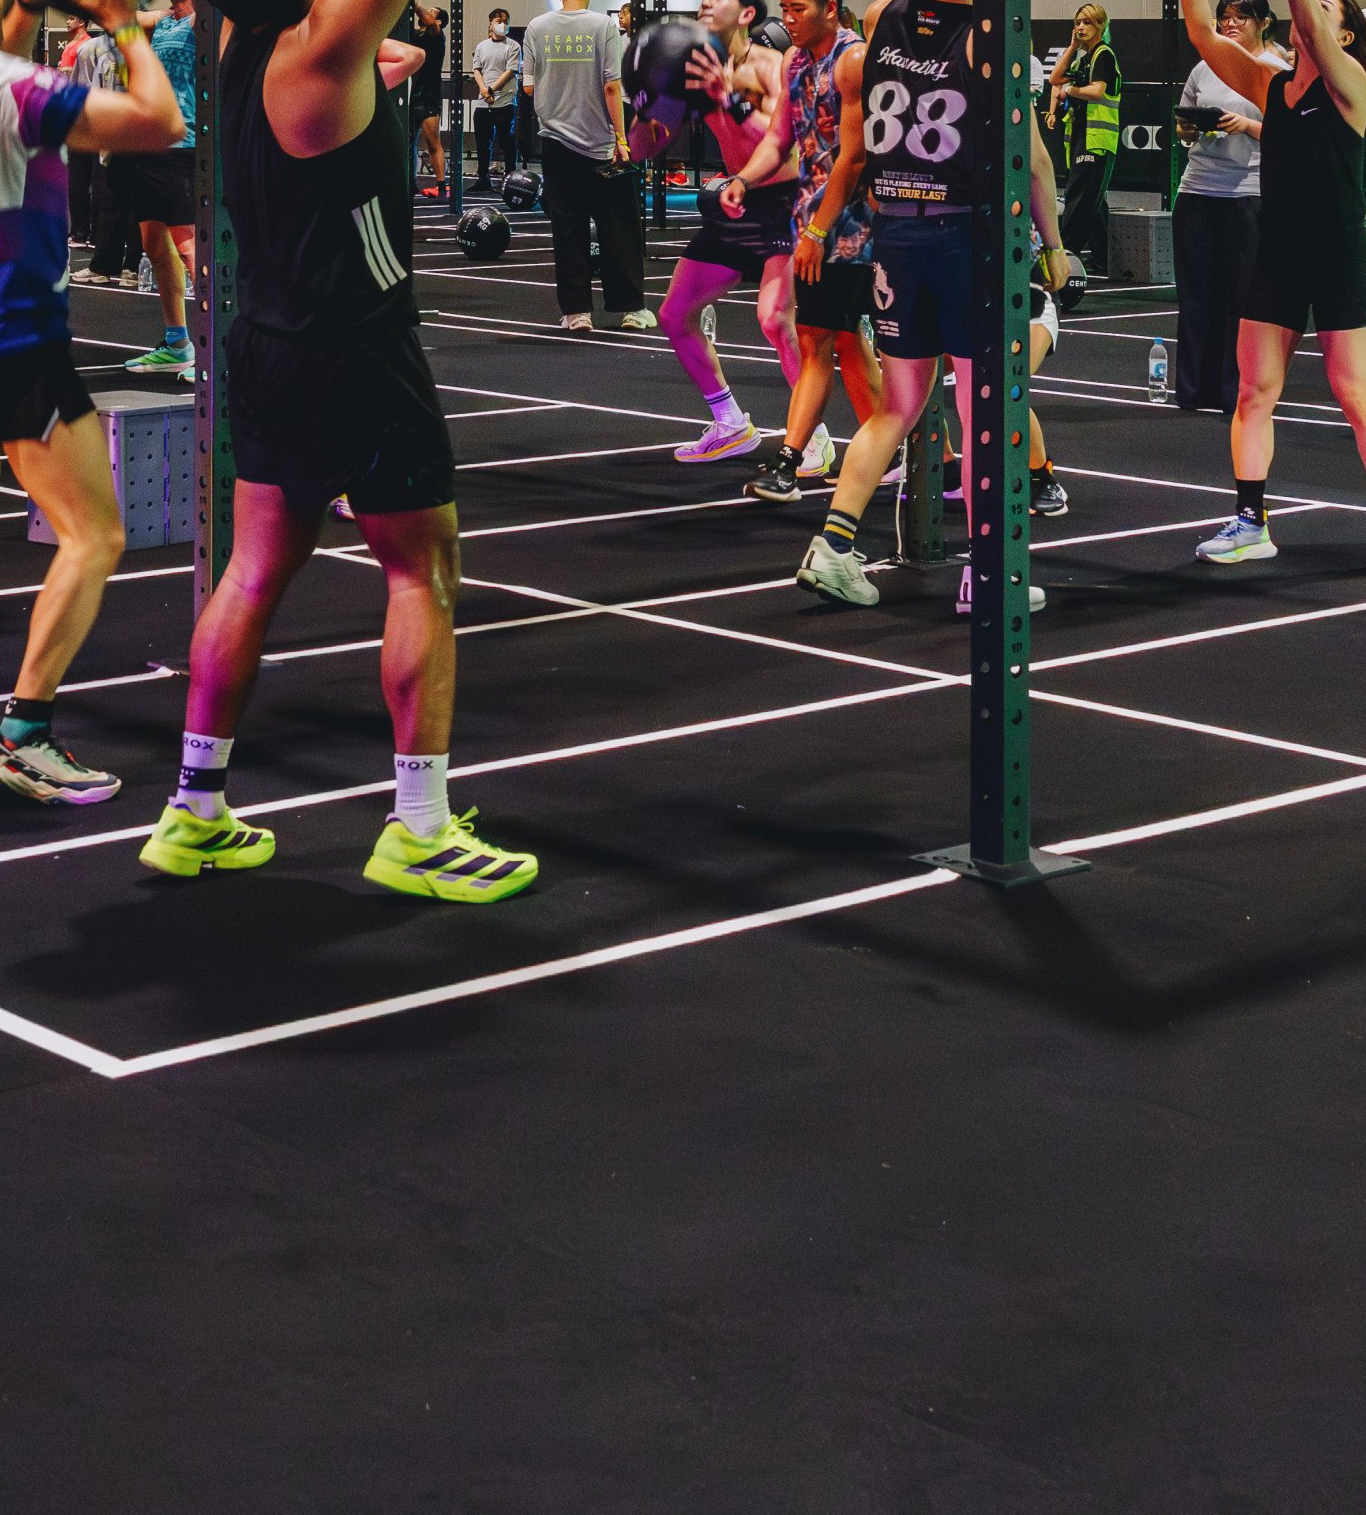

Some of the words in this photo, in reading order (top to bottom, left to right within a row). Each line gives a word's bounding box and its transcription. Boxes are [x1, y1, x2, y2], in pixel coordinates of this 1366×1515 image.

[544, 35, 583, 43] TEAM
[544, 45, 593, 53] HYROX
[863, 80, 967, 163] 88
[876, 186, 882, 195] S
[897, 187, 921, 199] YOUR
[922, 190, 947, 201] LAST
